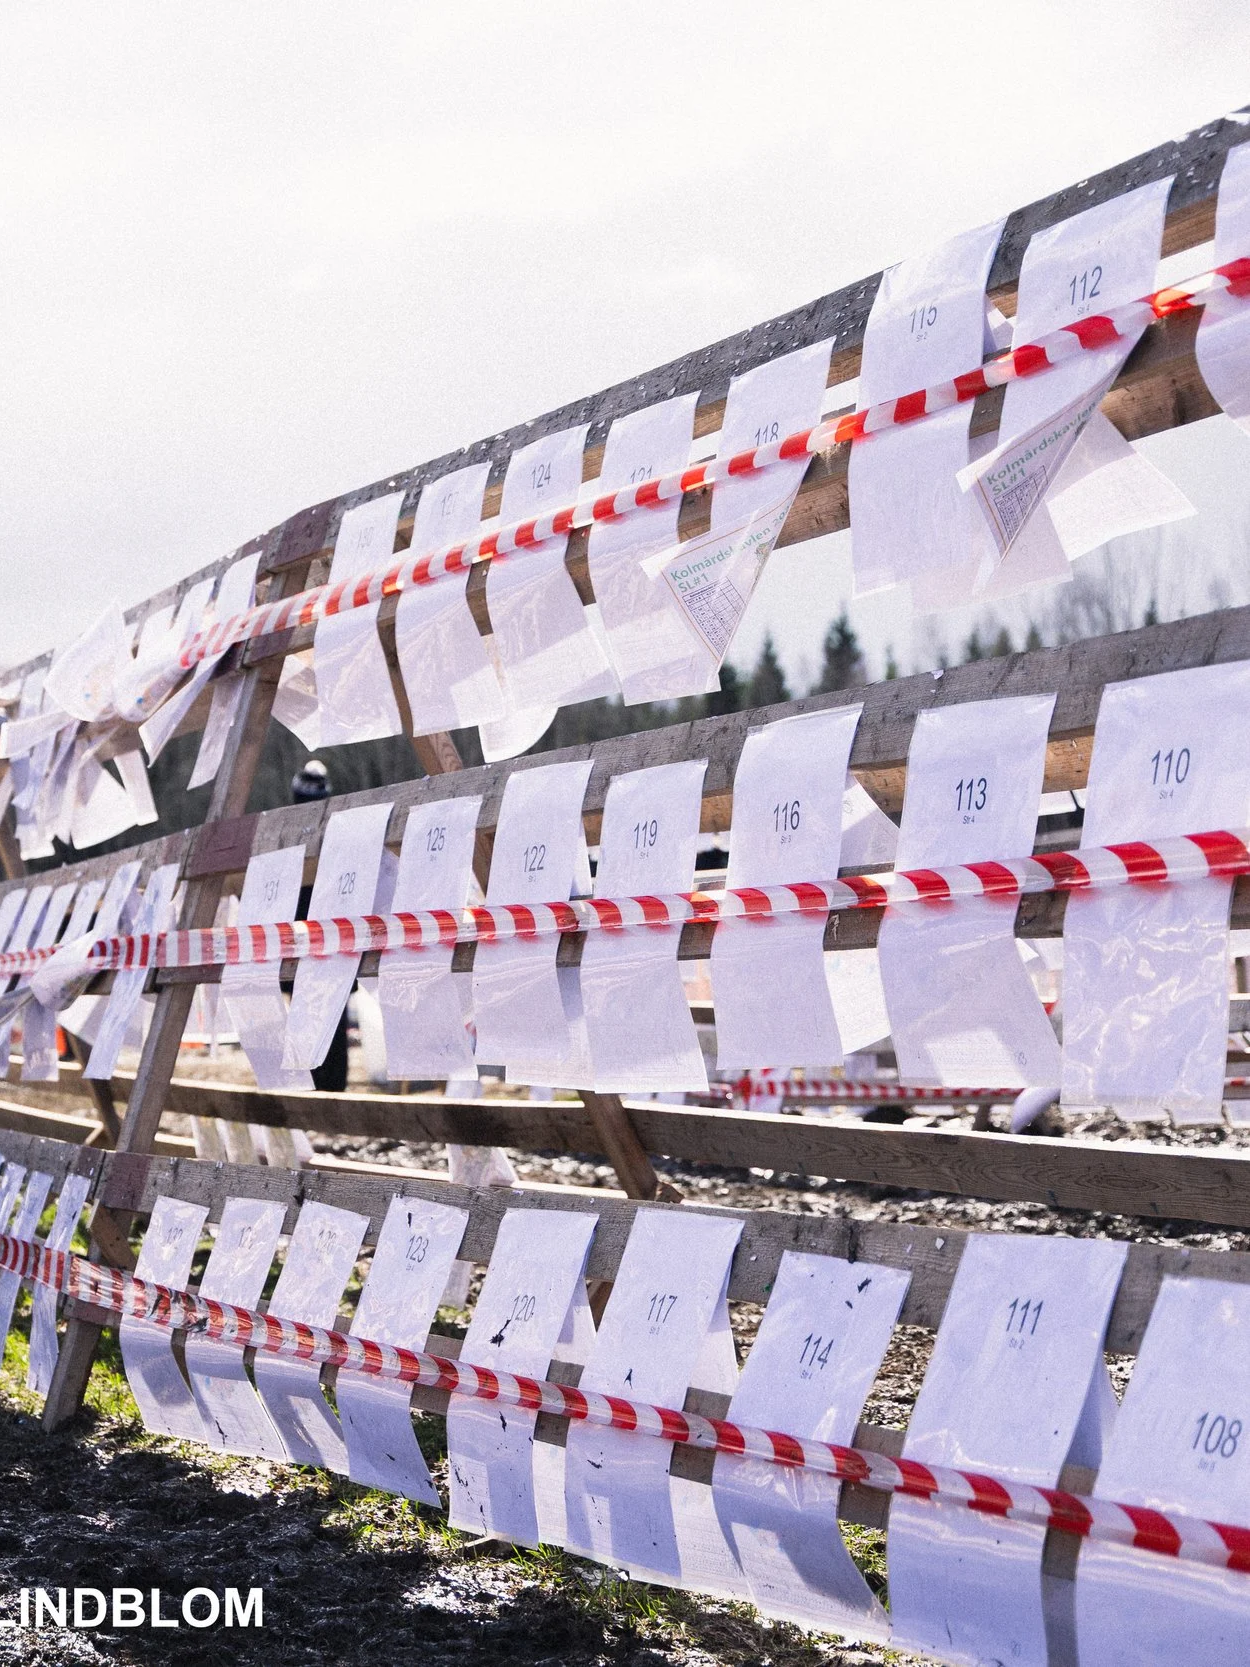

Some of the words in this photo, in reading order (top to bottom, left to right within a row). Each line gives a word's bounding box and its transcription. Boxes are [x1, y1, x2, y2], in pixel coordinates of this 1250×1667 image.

[1069, 266, 1103, 305] 112
[910, 305, 937, 333] 115
[754, 422, 779, 446] 118
[531, 462, 551, 489] 124
[992, 468, 1027, 496] SL#1
[678, 572, 710, 593] SL#1
[1151, 748, 1190, 785] 110
[955, 777, 988, 811] 113
[773, 800, 800, 832] 116
[426, 827, 447, 852] 125
[634, 819, 658, 849] 119
[523, 844, 547, 872] 122
[337, 872, 356, 895] 128
[406, 1235, 430, 1263] 123
[511, 1294, 536, 1322] 120
[647, 1293, 677, 1323] 117
[1005, 1298, 1044, 1335] 111
[799, 1332, 834, 1370] 114
[1193, 1411, 1242, 1459] 108
